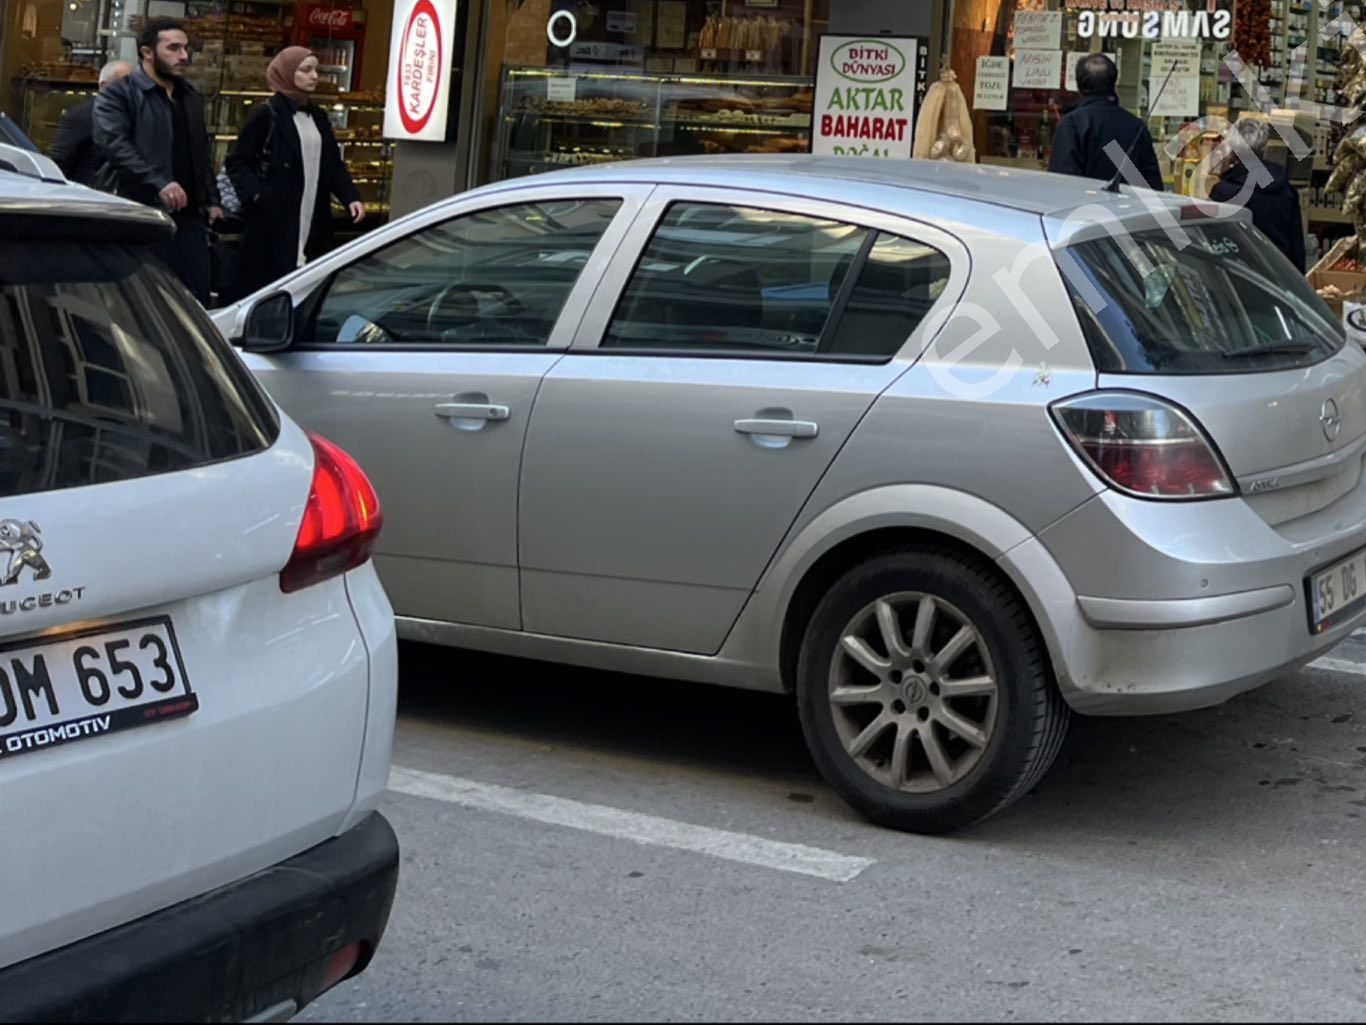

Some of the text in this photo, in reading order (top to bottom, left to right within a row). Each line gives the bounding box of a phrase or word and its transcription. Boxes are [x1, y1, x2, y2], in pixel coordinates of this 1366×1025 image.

[409, 16, 428, 115] KARDEŞLER
[848, 45, 889, 60] BİTKİ
[842, 60, 896, 76] DÜNYASI
[826, 87, 905, 112] AKTAR
[820, 114, 908, 142] BAHARAT
[0, 586, 86, 616] UGEOT
[72, 633, 176, 707] 653
